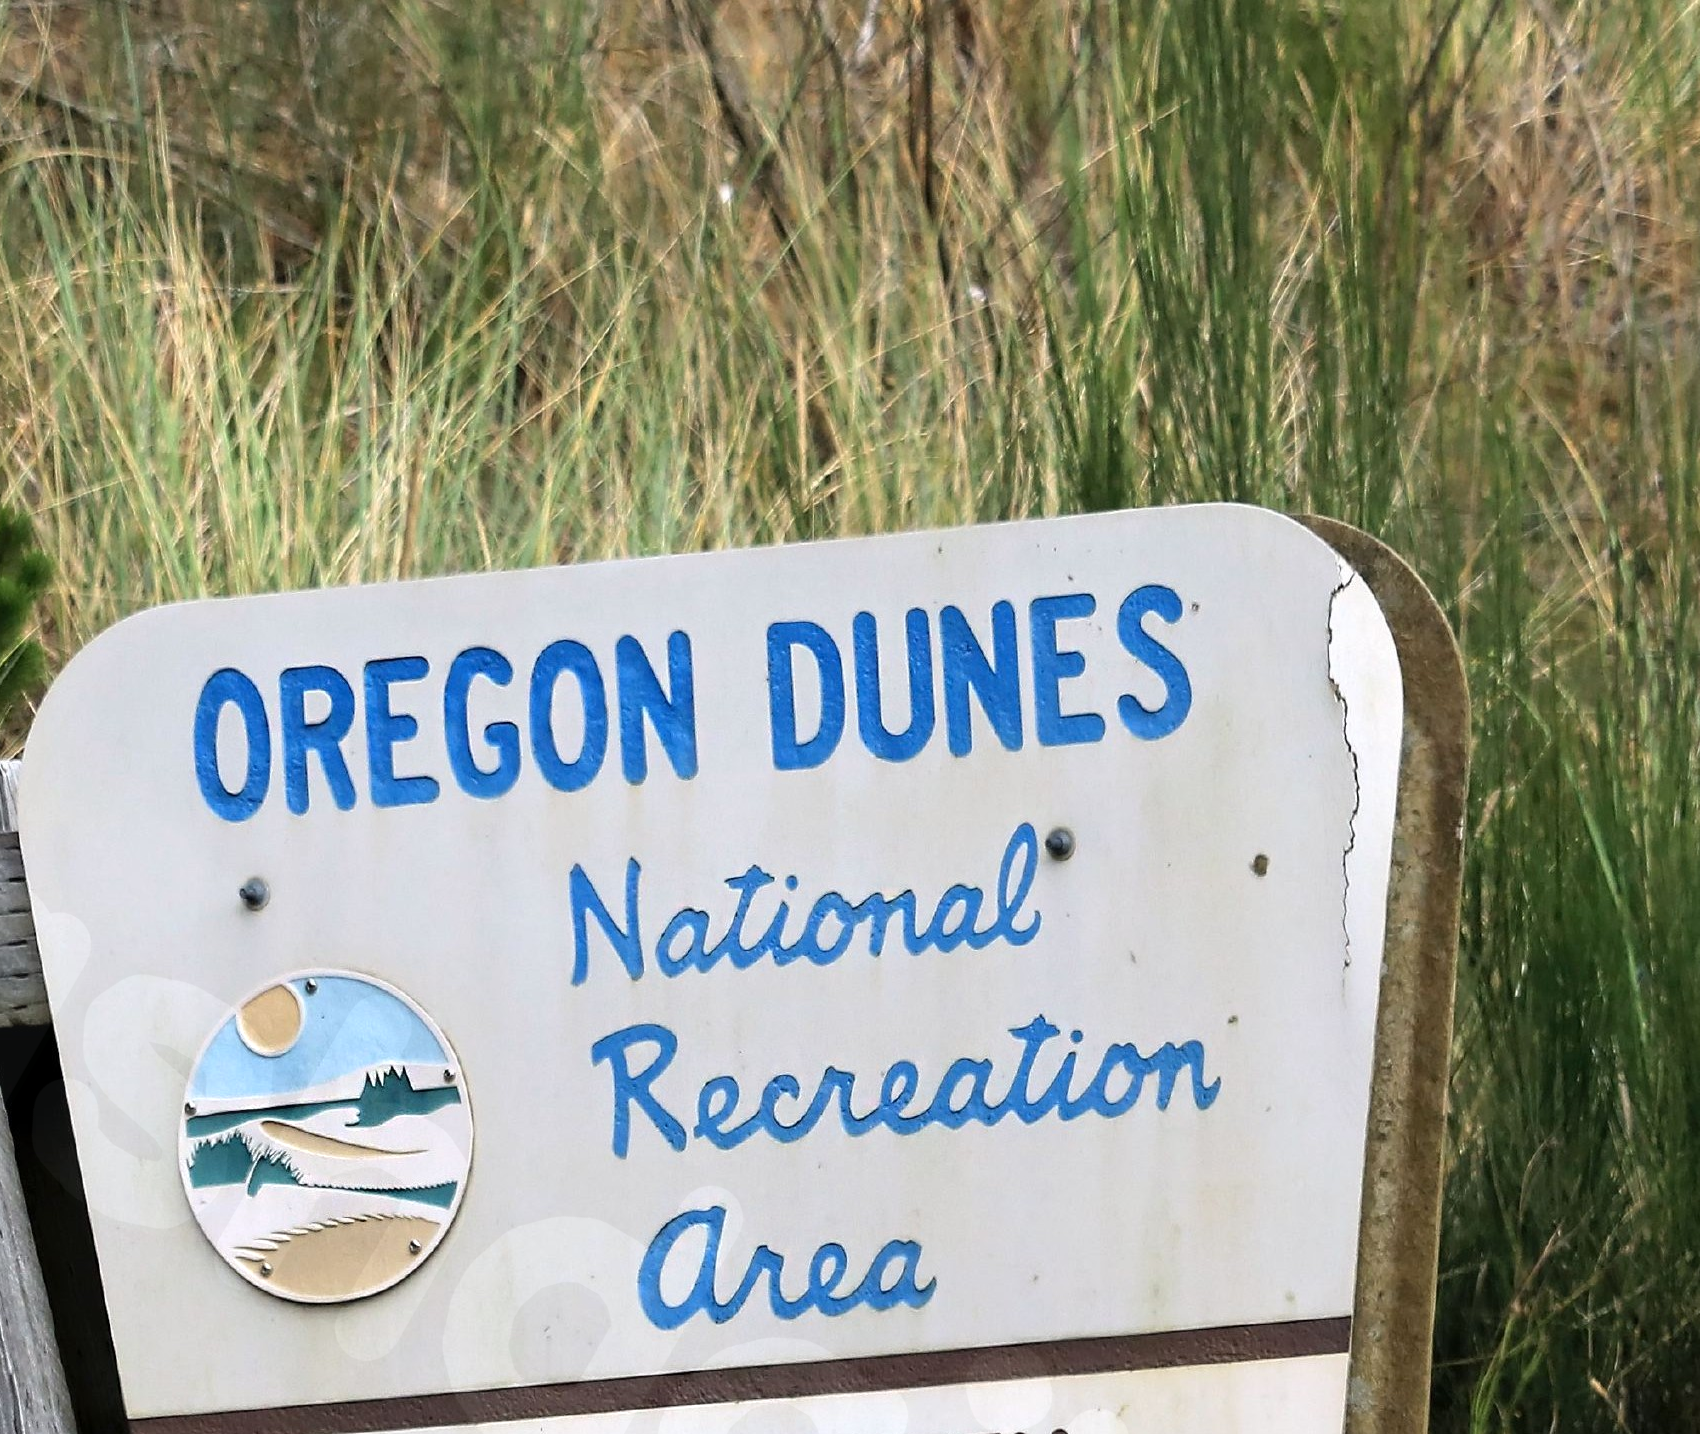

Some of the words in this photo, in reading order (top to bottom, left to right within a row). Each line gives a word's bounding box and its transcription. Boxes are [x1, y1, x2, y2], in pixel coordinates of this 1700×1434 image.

[192, 630, 698, 823] OREGON
[765, 584, 1193, 772] DUNES
[568, 823, 1042, 985] National
[590, 1014, 1220, 1158] Recreation
[637, 1205, 937, 1331] Area
